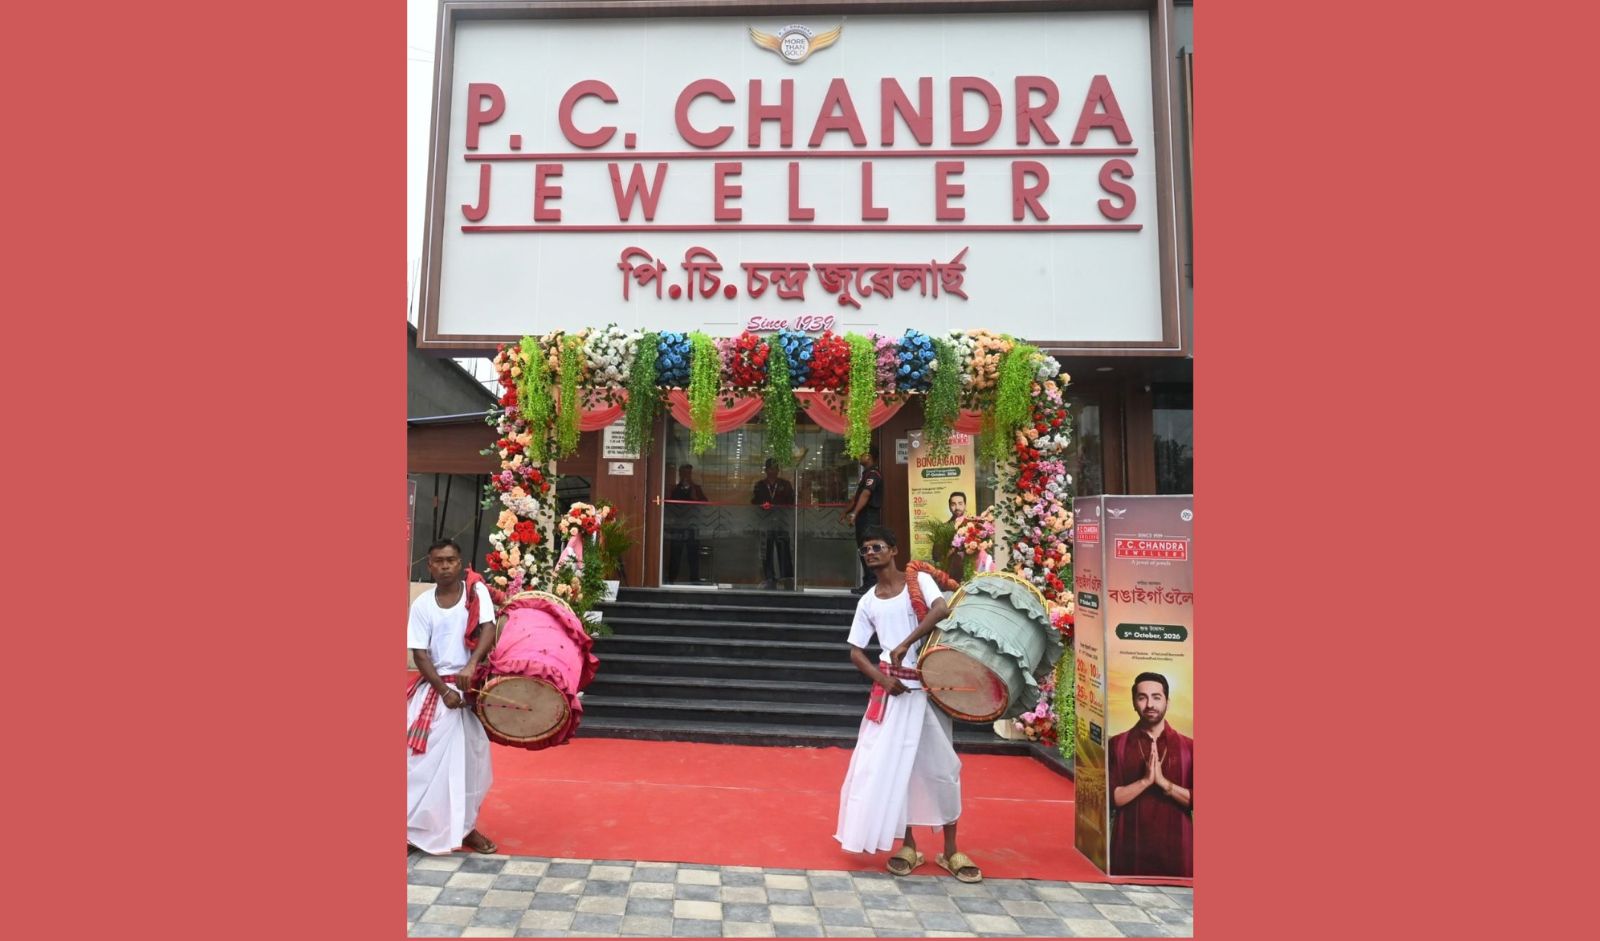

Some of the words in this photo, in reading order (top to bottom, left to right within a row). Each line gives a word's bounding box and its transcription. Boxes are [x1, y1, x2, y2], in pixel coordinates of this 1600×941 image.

[466, 83, 523, 150] P.
[558, 79, 637, 149] C.
[674, 75, 1133, 149] CHANDRA
[461, 159, 1138, 223] JEWELLERS
[746, 315, 789, 331] Since
[794, 313, 835, 332] 1939
[1138, 541, 1184, 551] CHANDRA
[1133, 631, 1162, 639] October,
